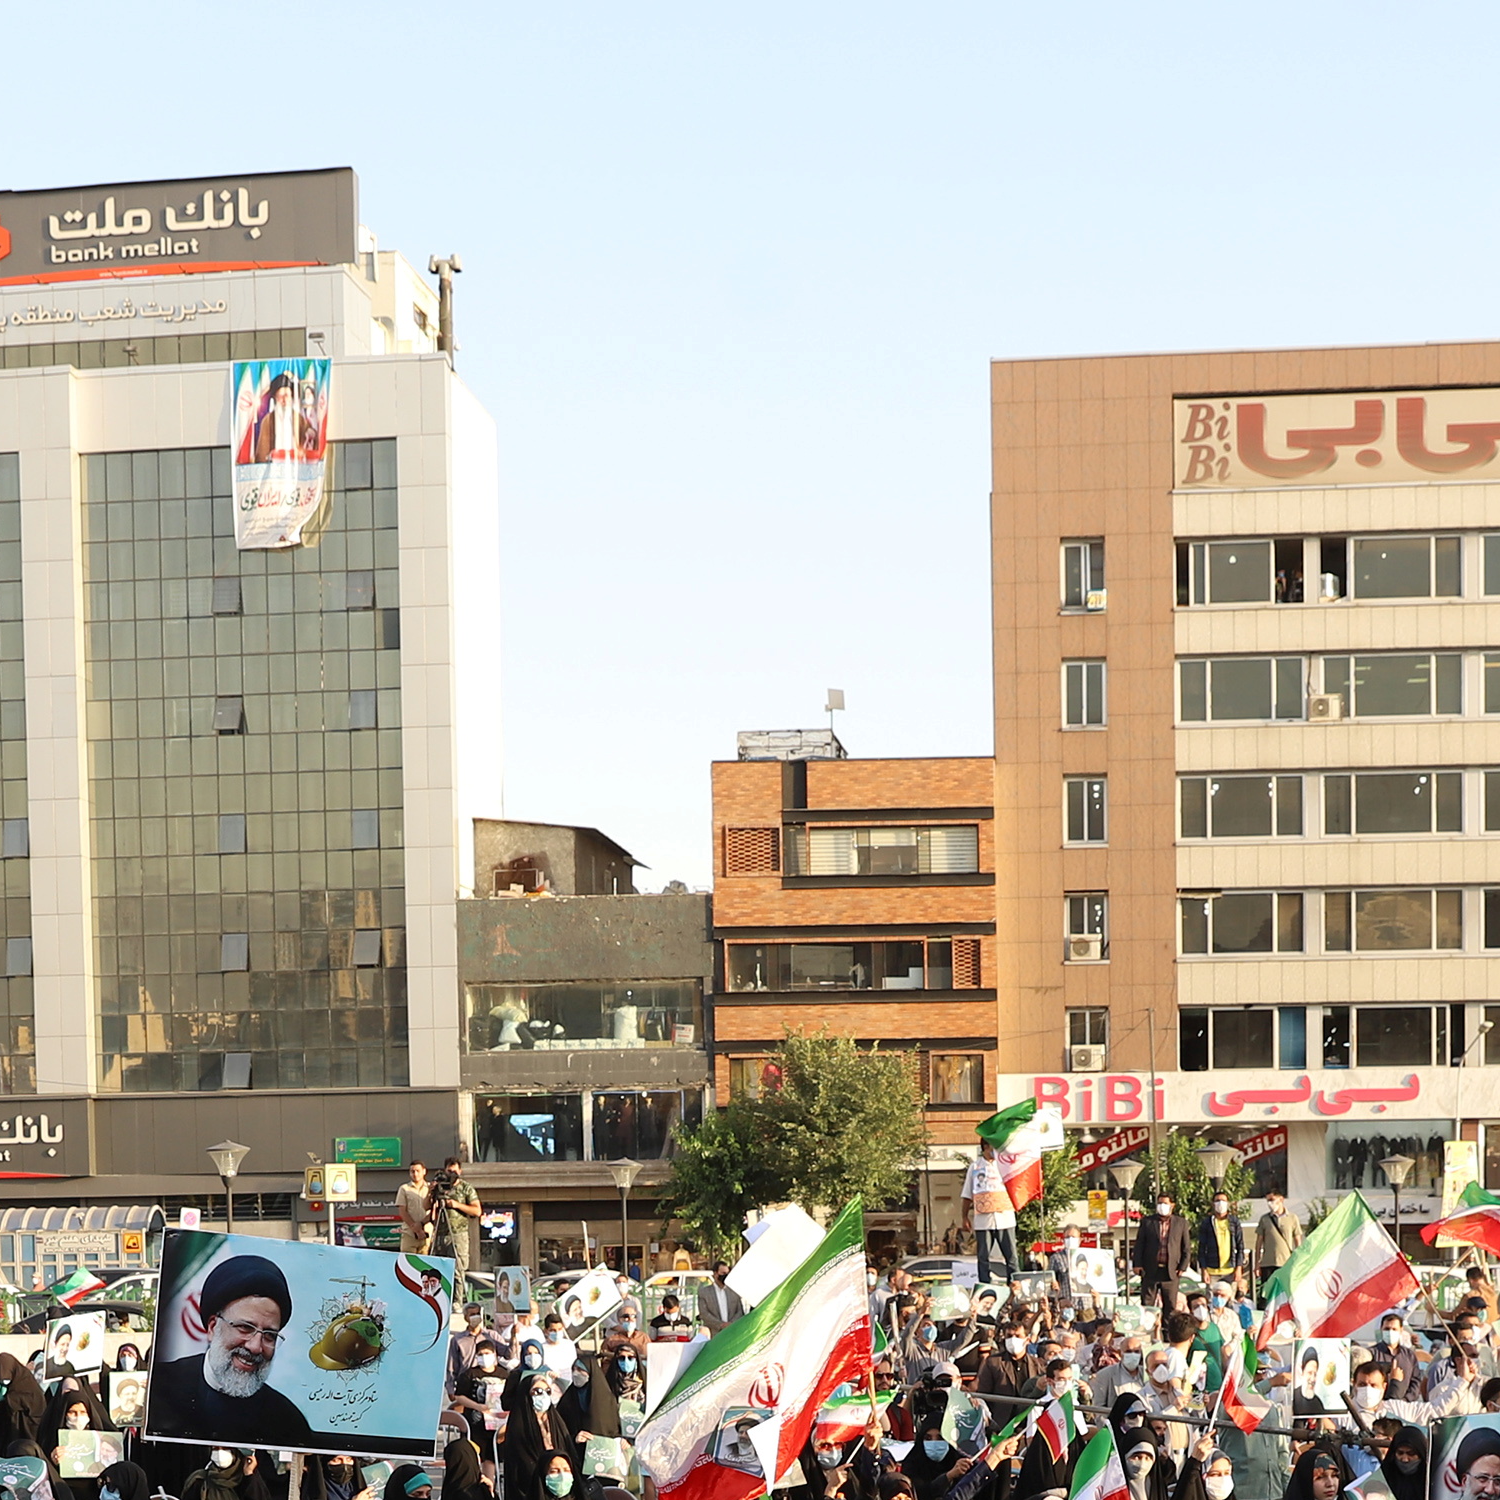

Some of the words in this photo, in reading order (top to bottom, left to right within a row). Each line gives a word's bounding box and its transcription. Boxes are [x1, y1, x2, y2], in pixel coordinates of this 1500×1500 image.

[49, 196, 152, 241] ملت
[51, 241, 114, 264] bank
[122, 236, 200, 259] mellat
[11, 303, 75, 327] منطقه
[78, 297, 136, 327] شعب
[140, 296, 227, 324] مدیریت
[1182, 401, 1231, 443] Bi
[1236, 399, 1383, 479] بی
[1182, 443, 1231, 484] Bi
[1208, 1074, 1312, 1117] بی
[1316, 1074, 1421, 1115] بی
[1098, 1126, 1150, 1158] مانتو
